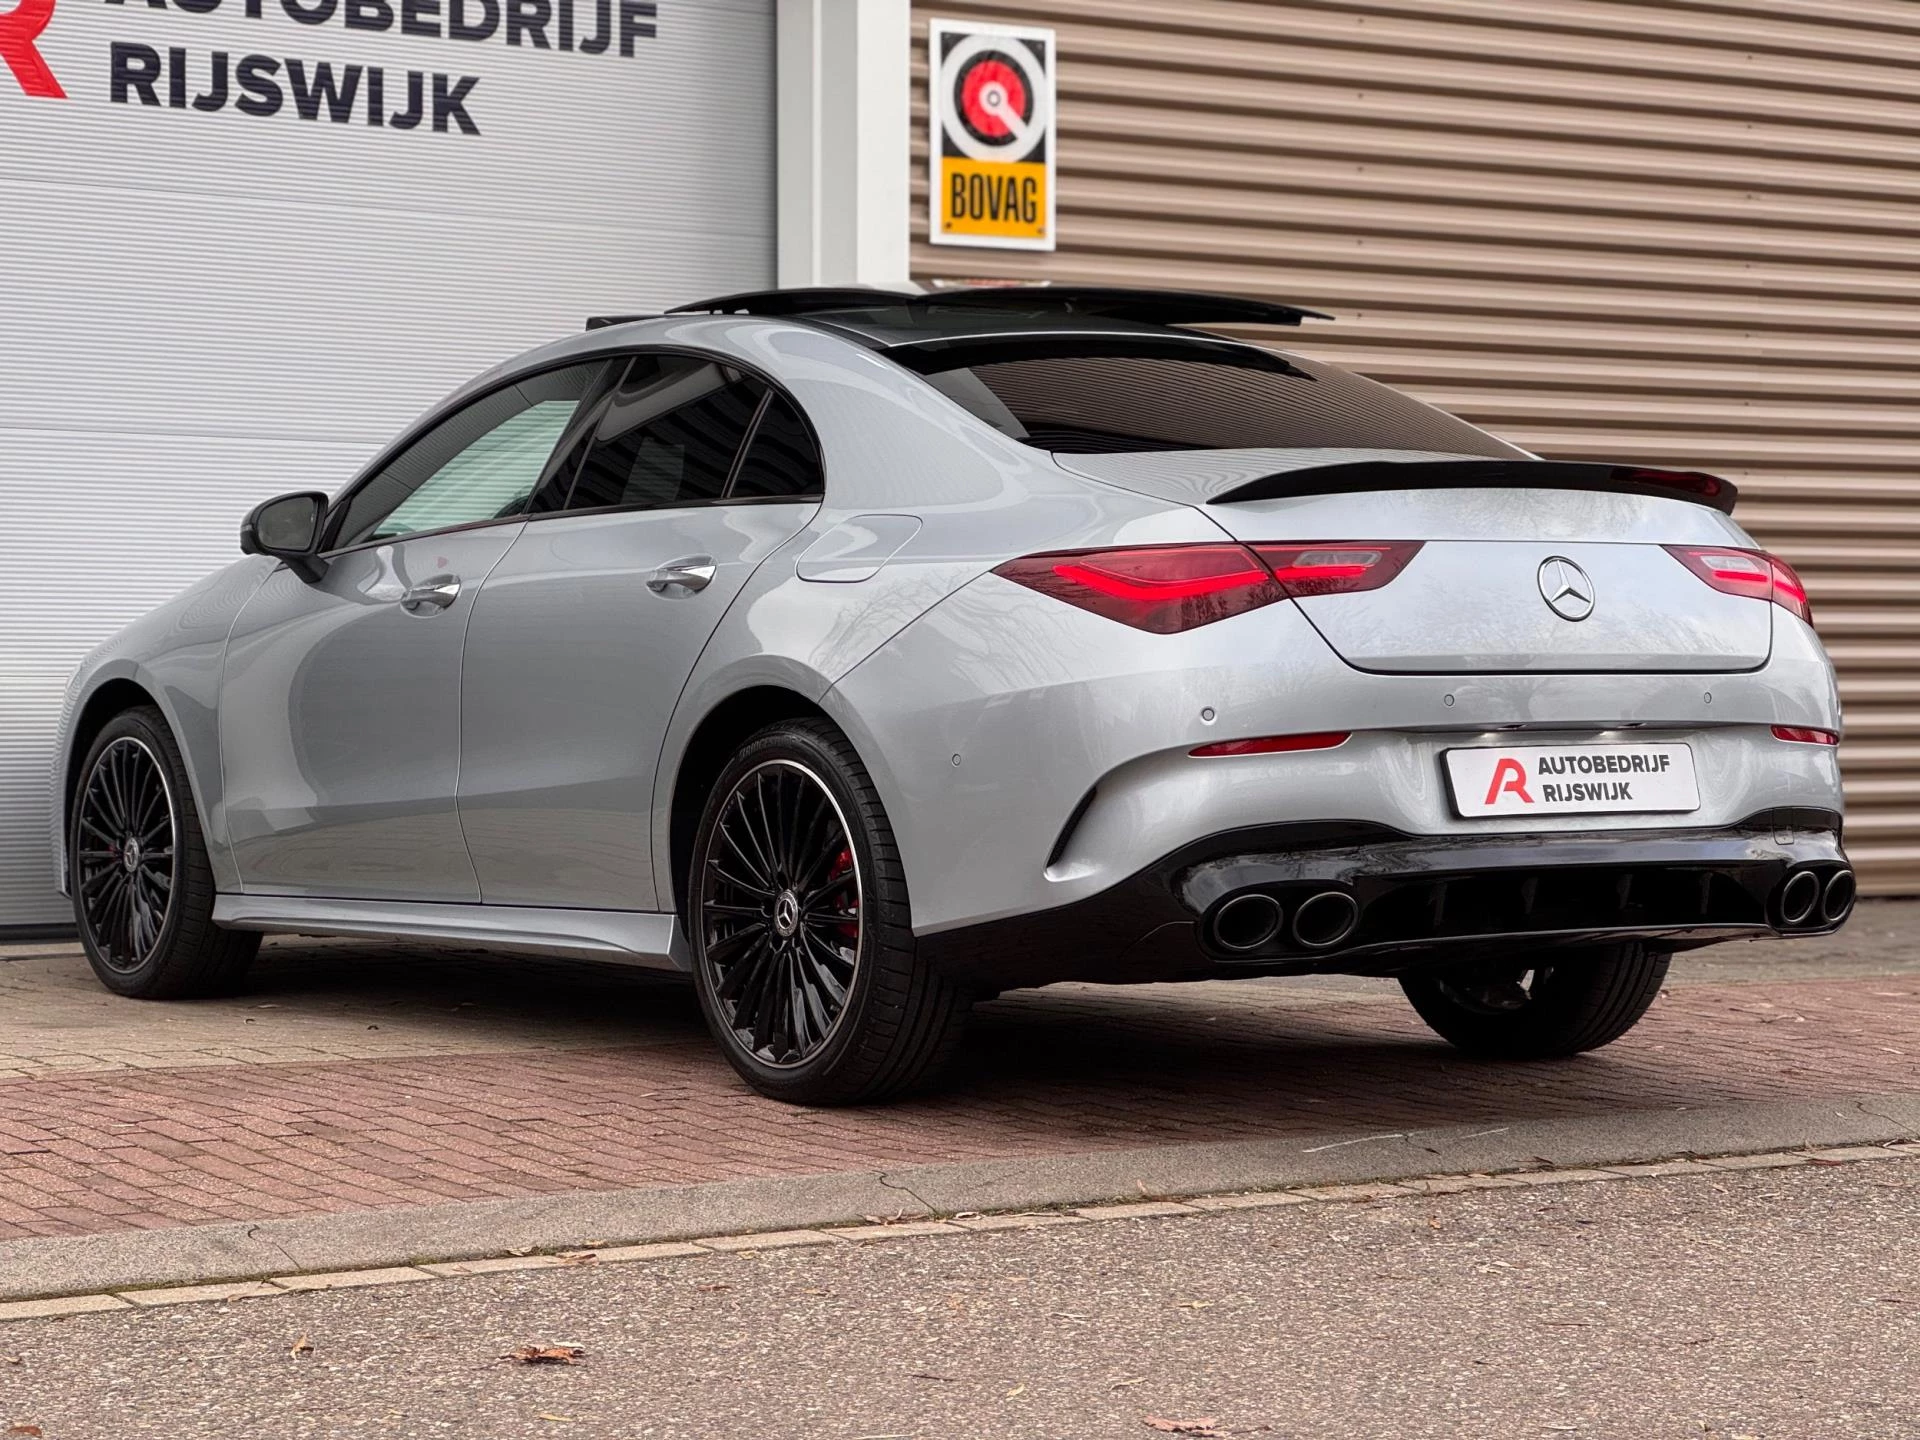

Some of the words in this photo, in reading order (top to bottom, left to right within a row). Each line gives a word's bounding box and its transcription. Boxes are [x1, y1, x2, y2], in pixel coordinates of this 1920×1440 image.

[104, 0, 658, 58] BEDRIJF
[109, 41, 482, 136] RIJSWIJK
[952, 172, 1037, 223] BOVAG
[1538, 754, 1670, 775] AUTOBEDRIJF
[1543, 782, 1633, 802] RIJSWIJK
